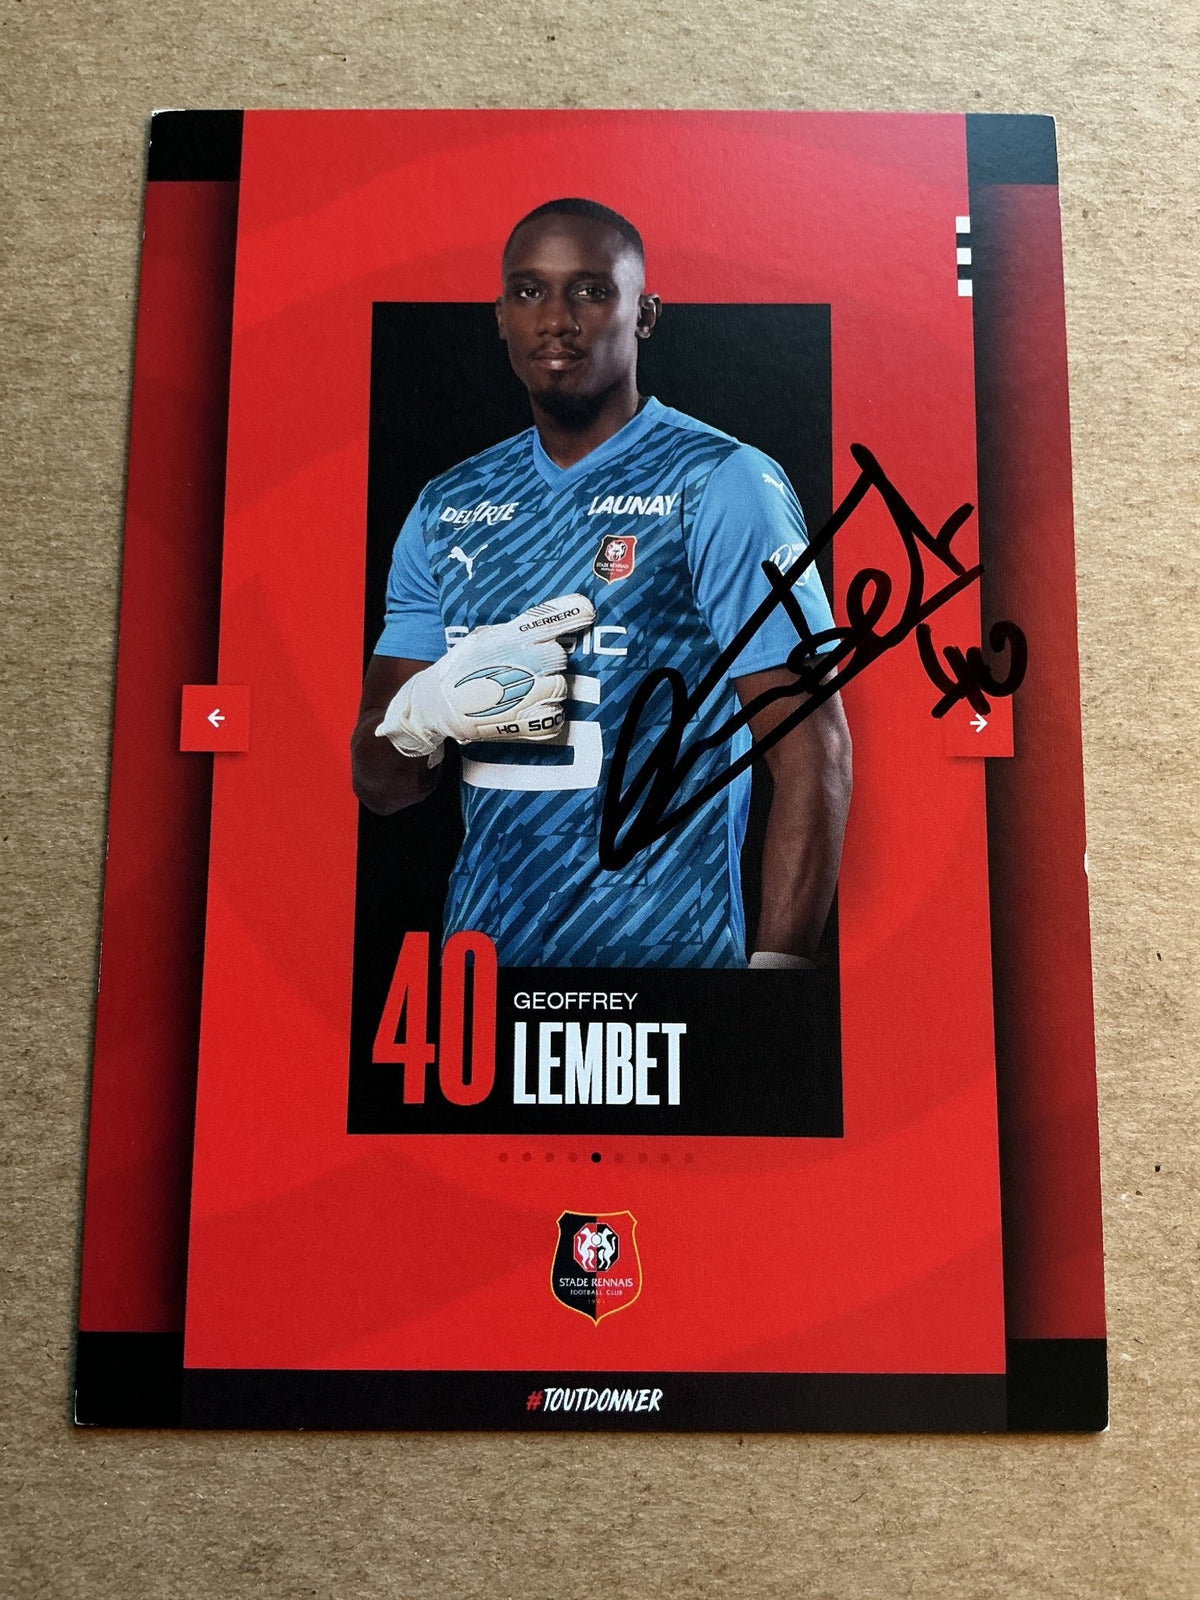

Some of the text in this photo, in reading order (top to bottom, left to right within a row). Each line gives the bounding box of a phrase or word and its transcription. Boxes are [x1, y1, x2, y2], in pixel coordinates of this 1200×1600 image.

[587, 493, 678, 516] LAUNAY
[519, 607, 580, 633] GUERRERO
[496, 712, 565, 735] HO SOC
[513, 992, 638, 1010] GEOFFREY
[372, 930, 498, 1106] 40
[513, 1021, 687, 1106] LEMBET
[559, 1278, 634, 1287] STADE RENNAIS
[526, 1388, 664, 1412] #TOUTDONNER
